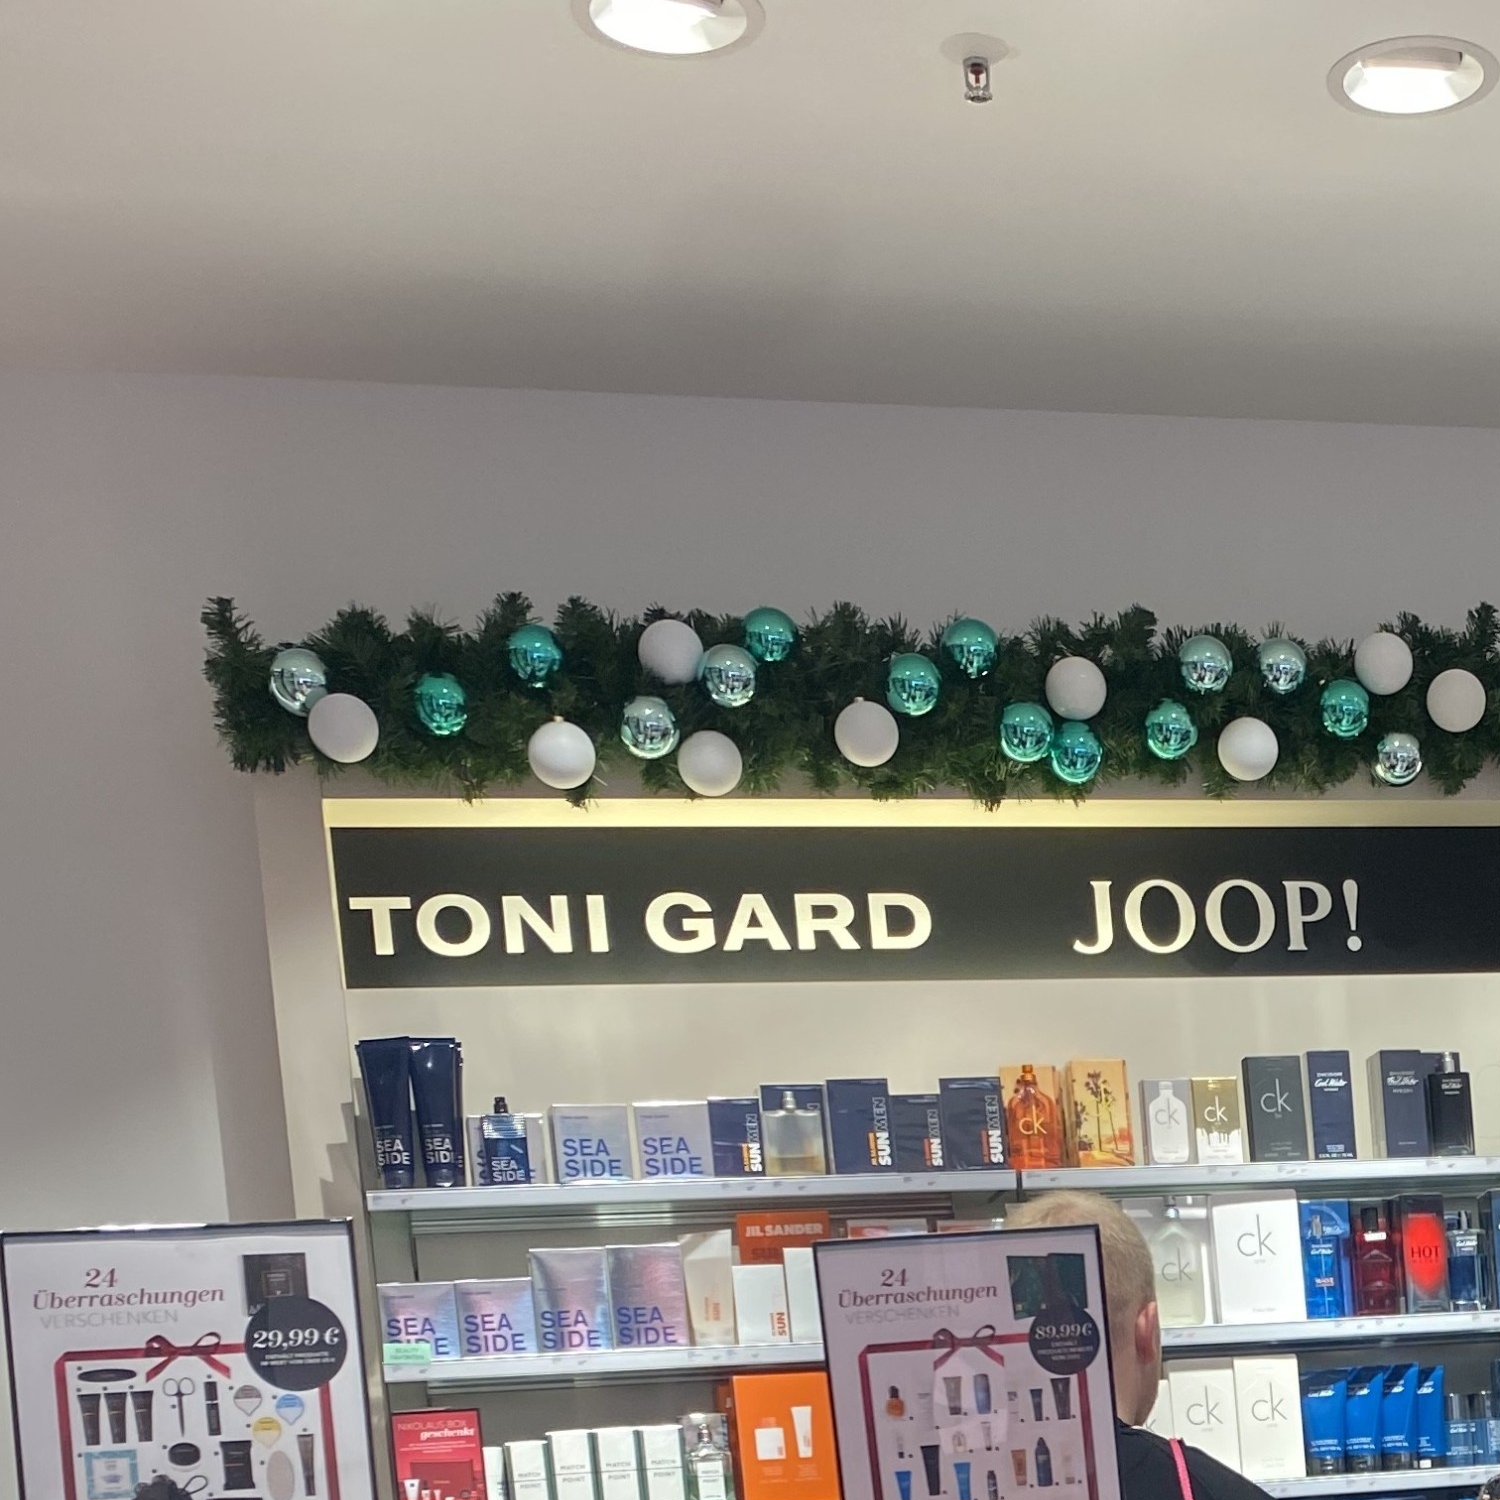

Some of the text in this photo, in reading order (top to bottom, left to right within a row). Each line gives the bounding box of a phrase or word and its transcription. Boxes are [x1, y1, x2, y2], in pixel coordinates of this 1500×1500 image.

[349, 891, 933, 957] TONI GARD
[1072, 878, 1363, 955] JOOP!
[1260, 1078, 1293, 1113] ck
[1018, 1103, 1048, 1135] ck
[1154, 1097, 1180, 1126] ck
[1204, 1095, 1228, 1123] ck
[376, 1137, 404, 1154] SEA
[424, 1137, 453, 1151] SEA
[563, 1138, 611, 1158] SEA
[643, 1136, 691, 1156] SEA
[377, 1151, 412, 1167] SIDE
[491, 1159, 518, 1172] SEA
[564, 1158, 623, 1178] SIDE
[645, 1156, 704, 1176] SIDE
[492, 1169, 526, 1182] SIDE
[764, 1223, 823, 1237] SANDER
[1237, 1213, 1277, 1257] ck
[1410, 1245, 1440, 1259] HOT
[1161, 1247, 1193, 1282] ck
[84, 1267, 118, 1289] 24
[880, 1268, 908, 1288] 24
[33, 1286, 225, 1310] Überraschungen
[838, 1284, 999, 1308] Überraschungen
[40, 1309, 179, 1329] VERSCHENKEN
[464, 1313, 513, 1333] SEA
[540, 1309, 588, 1328] SEA
[617, 1306, 664, 1324] SEA
[776, 1312, 787, 1336] SUN
[844, 1305, 961, 1326] VERSCHENKEN
[386, 1317, 436, 1337] SEA
[619, 1325, 678, 1345] SIDE
[252, 1326, 340, 1350] 29,99 €
[466, 1333, 527, 1353] SIDE
[542, 1329, 602, 1349] SIDE
[1186, 1385, 1224, 1426] ck
[1251, 1382, 1288, 1422] ck
[420, 1427, 475, 1441] geschenkt
